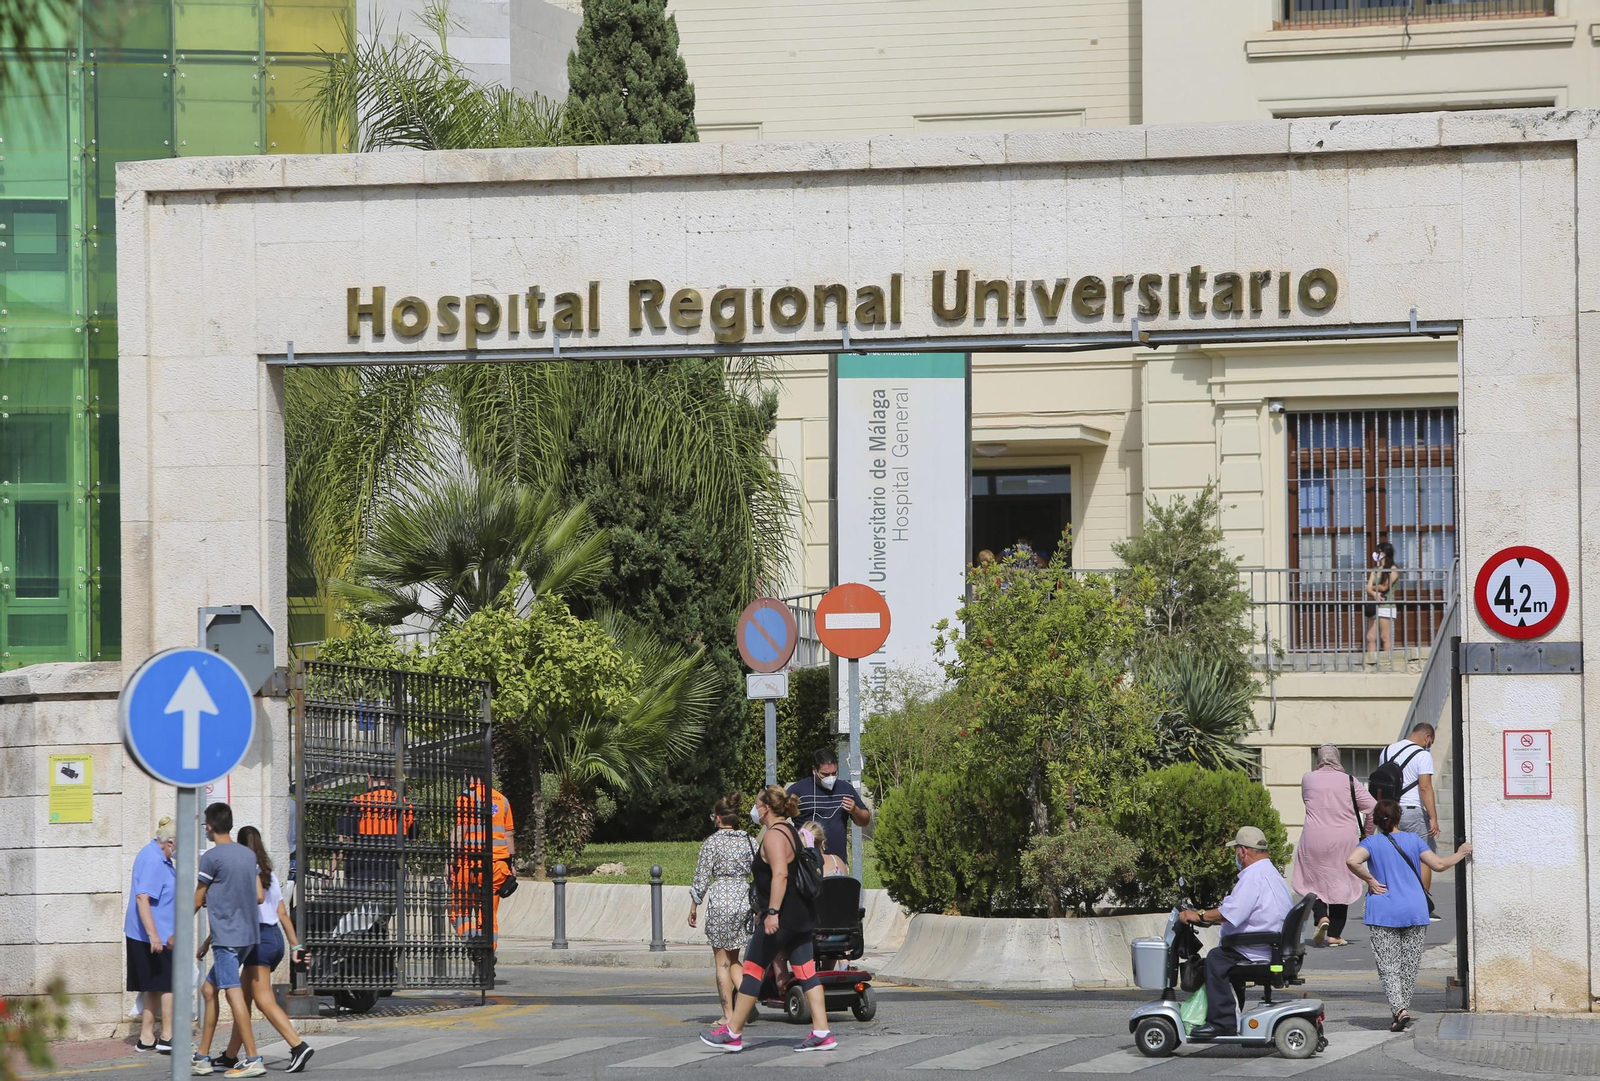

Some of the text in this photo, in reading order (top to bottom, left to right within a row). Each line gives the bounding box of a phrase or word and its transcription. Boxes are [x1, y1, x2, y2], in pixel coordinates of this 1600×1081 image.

[347, 265, 1339, 349] Hospital Regional Universitario
[868, 389, 890, 451] Málaga
[868, 458, 886, 479] de
[891, 387, 912, 541] Hospital General
[868, 487, 886, 582] Universitario
